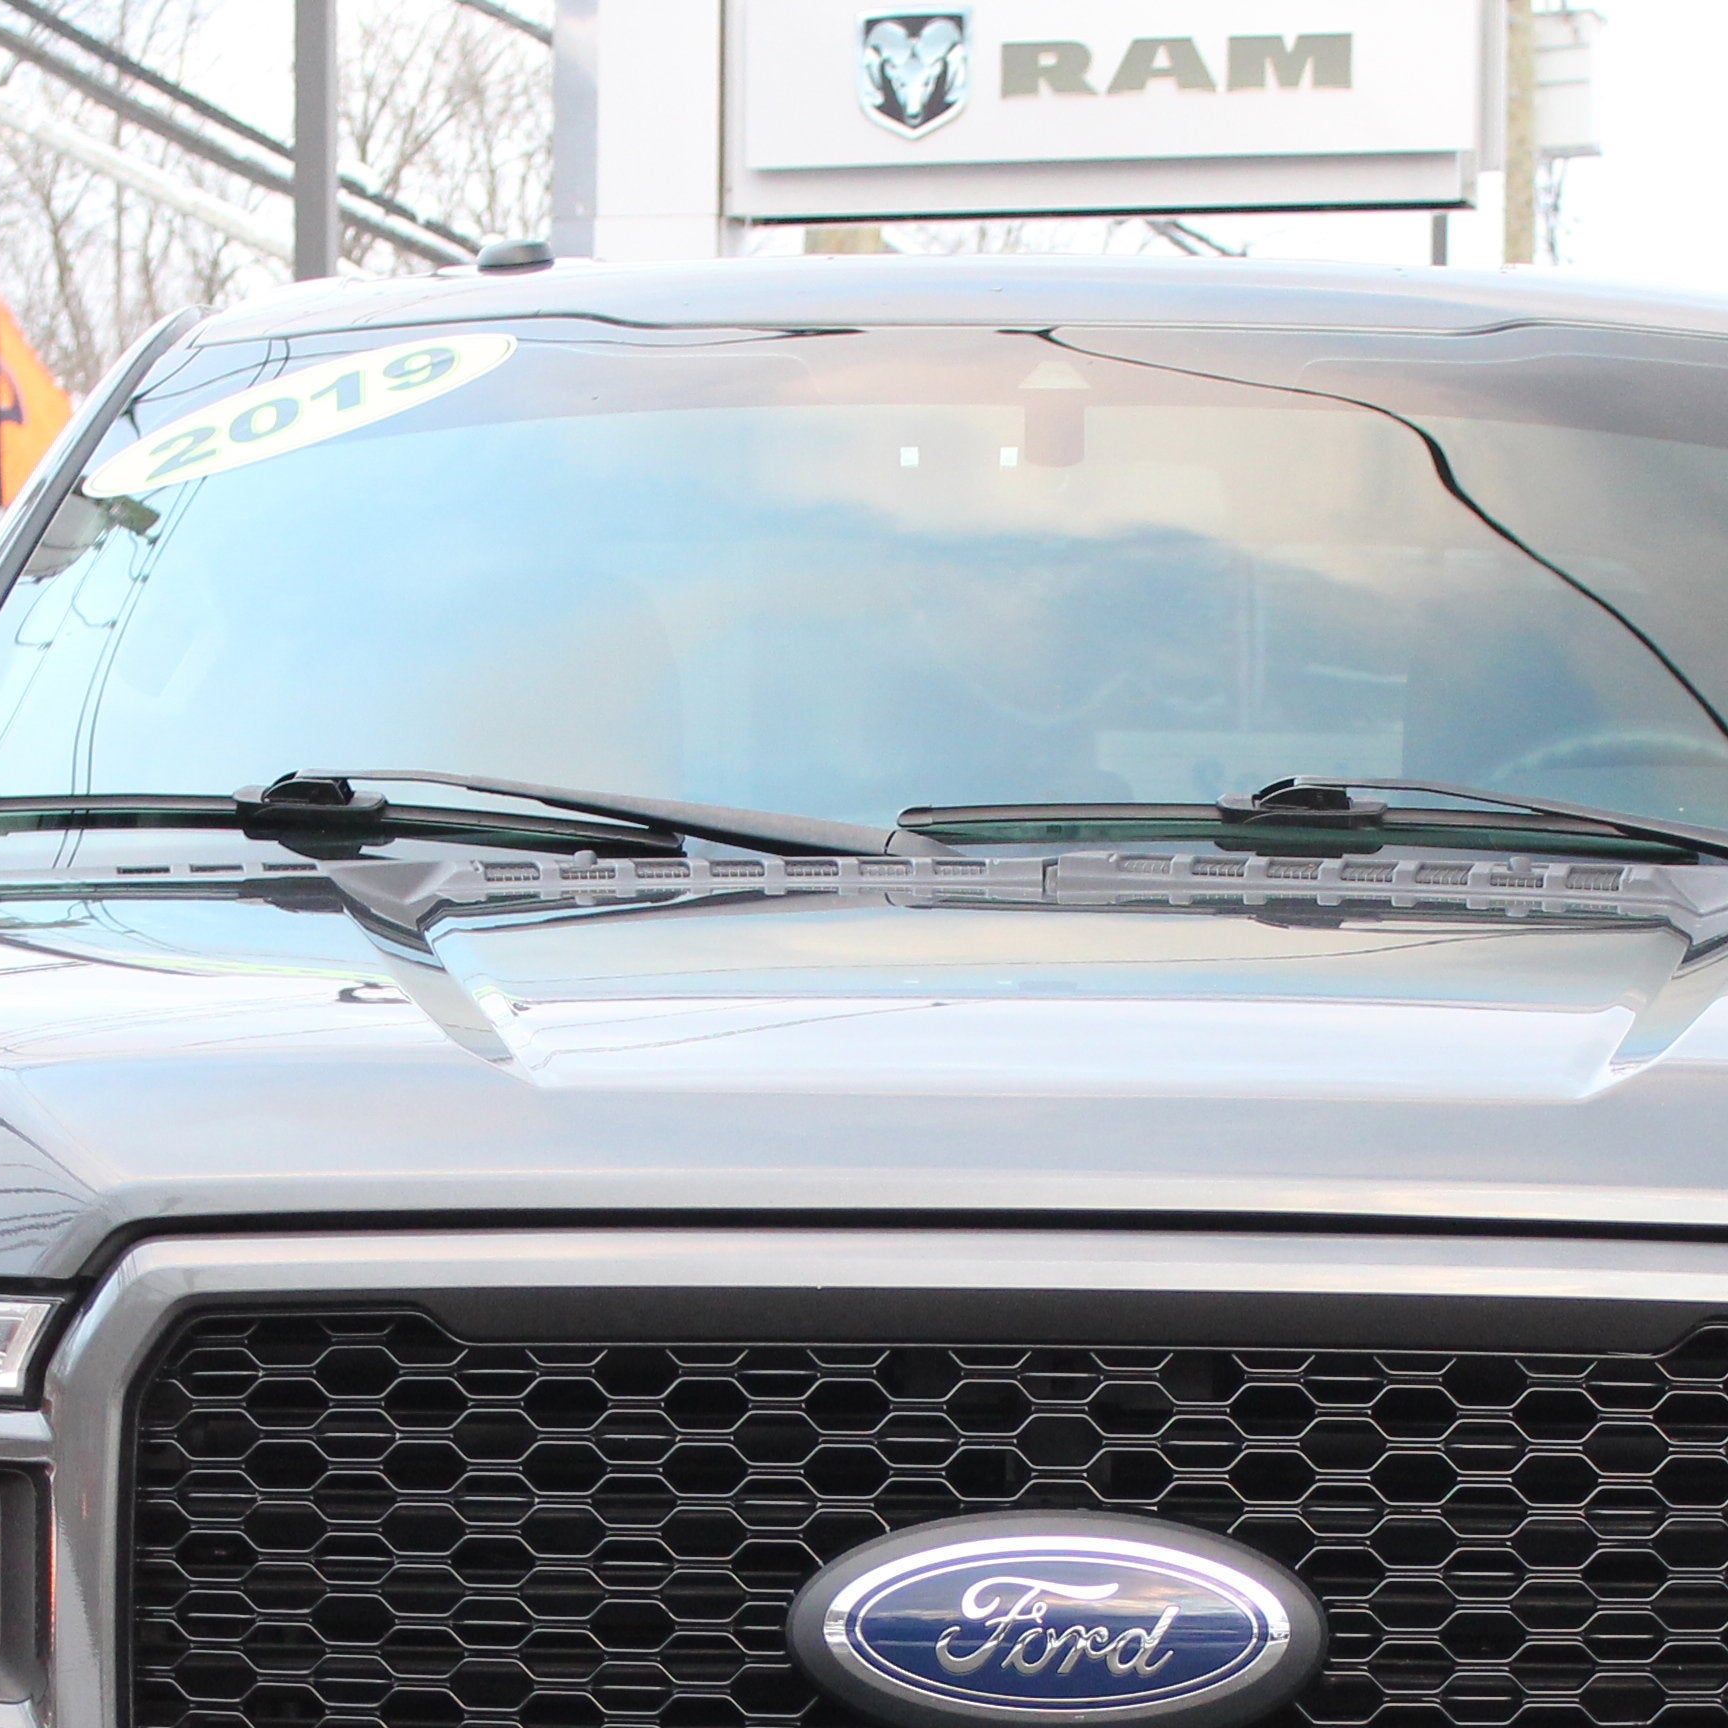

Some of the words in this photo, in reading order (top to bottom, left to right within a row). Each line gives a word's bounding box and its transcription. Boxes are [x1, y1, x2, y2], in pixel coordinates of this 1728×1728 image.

[1000, 32, 1354, 98] RAM
[144, 345, 461, 484] 2019
[934, 1575, 1182, 1677] Ford
